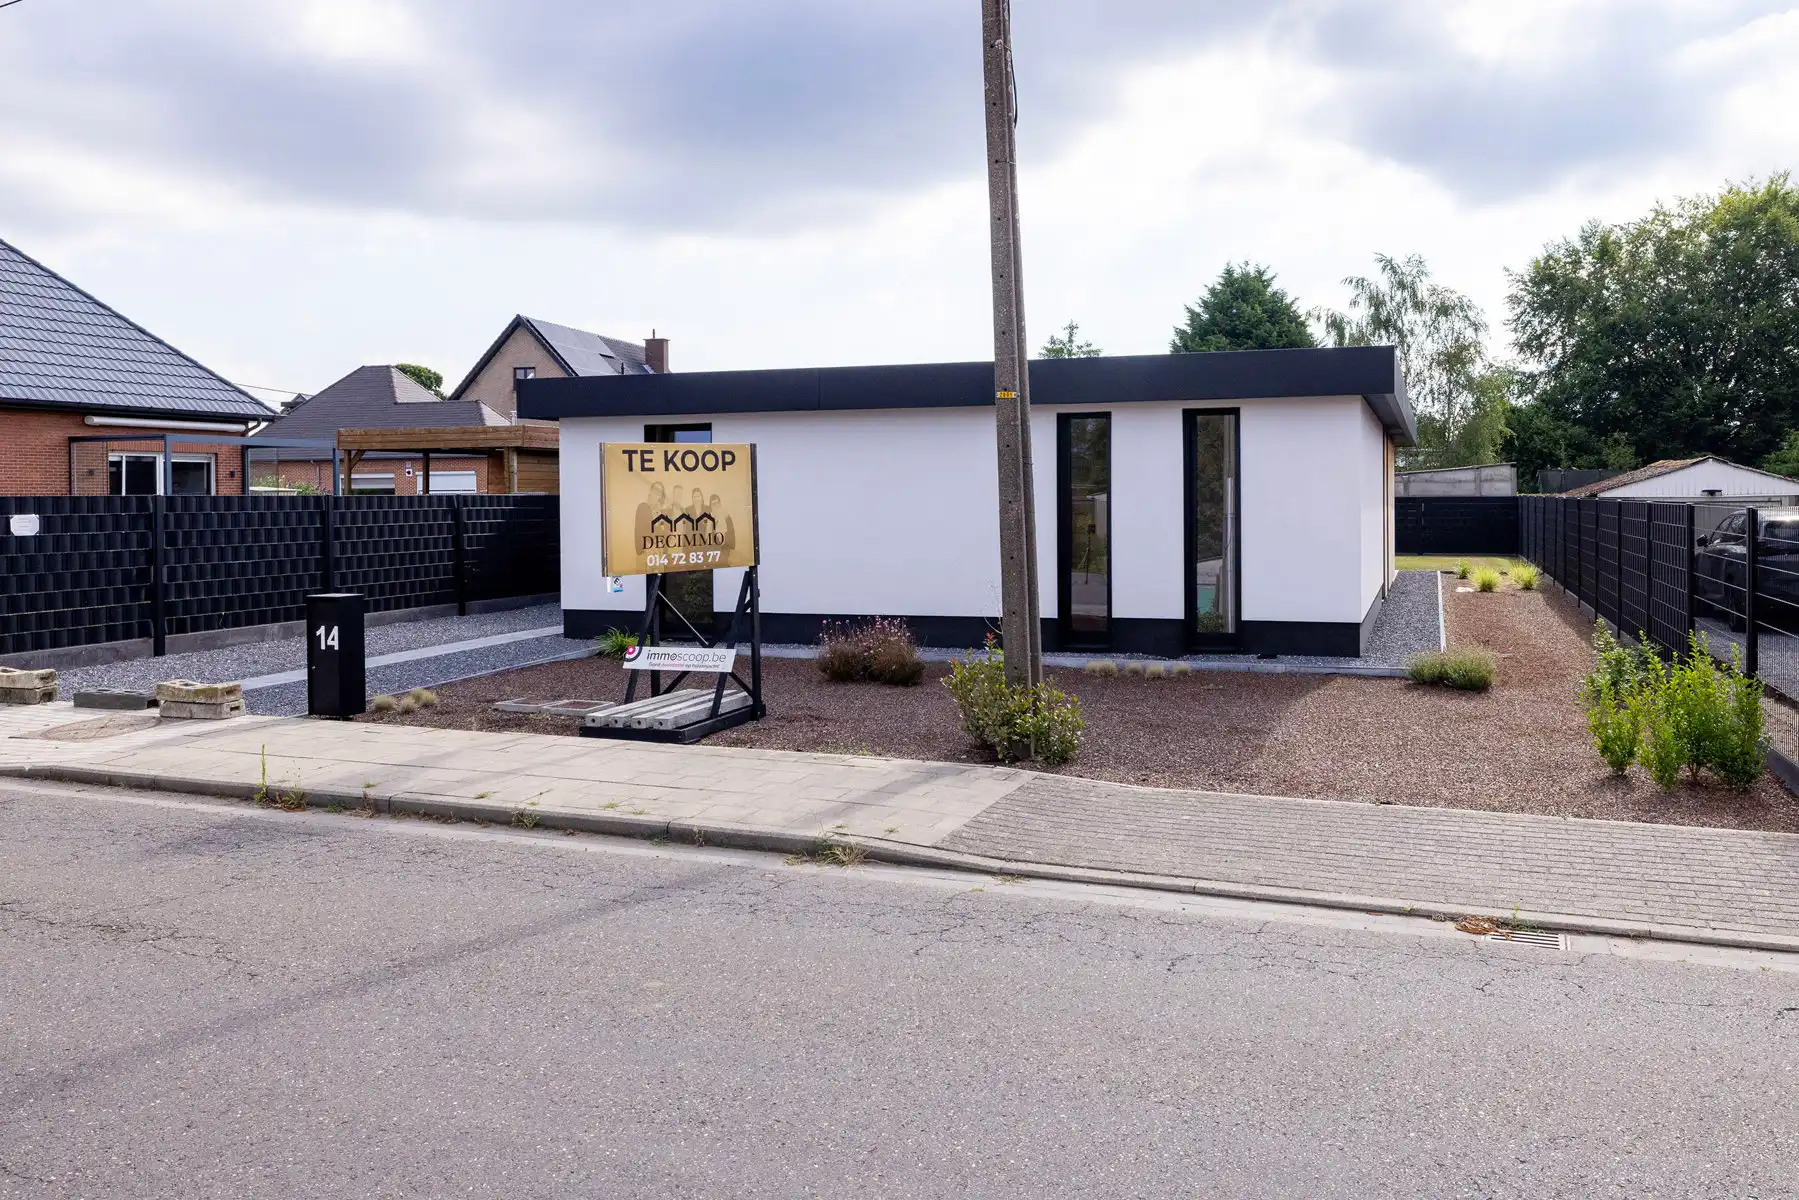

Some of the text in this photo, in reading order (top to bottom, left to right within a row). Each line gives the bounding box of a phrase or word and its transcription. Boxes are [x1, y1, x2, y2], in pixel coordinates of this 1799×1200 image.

[622, 449, 736, 472] TE KOOP
[642, 532, 725, 550] DECIMMO
[647, 550, 721, 567] 014 72 83 77
[316, 625, 339, 651] 14
[646, 649, 727, 663] immoscoop.be
